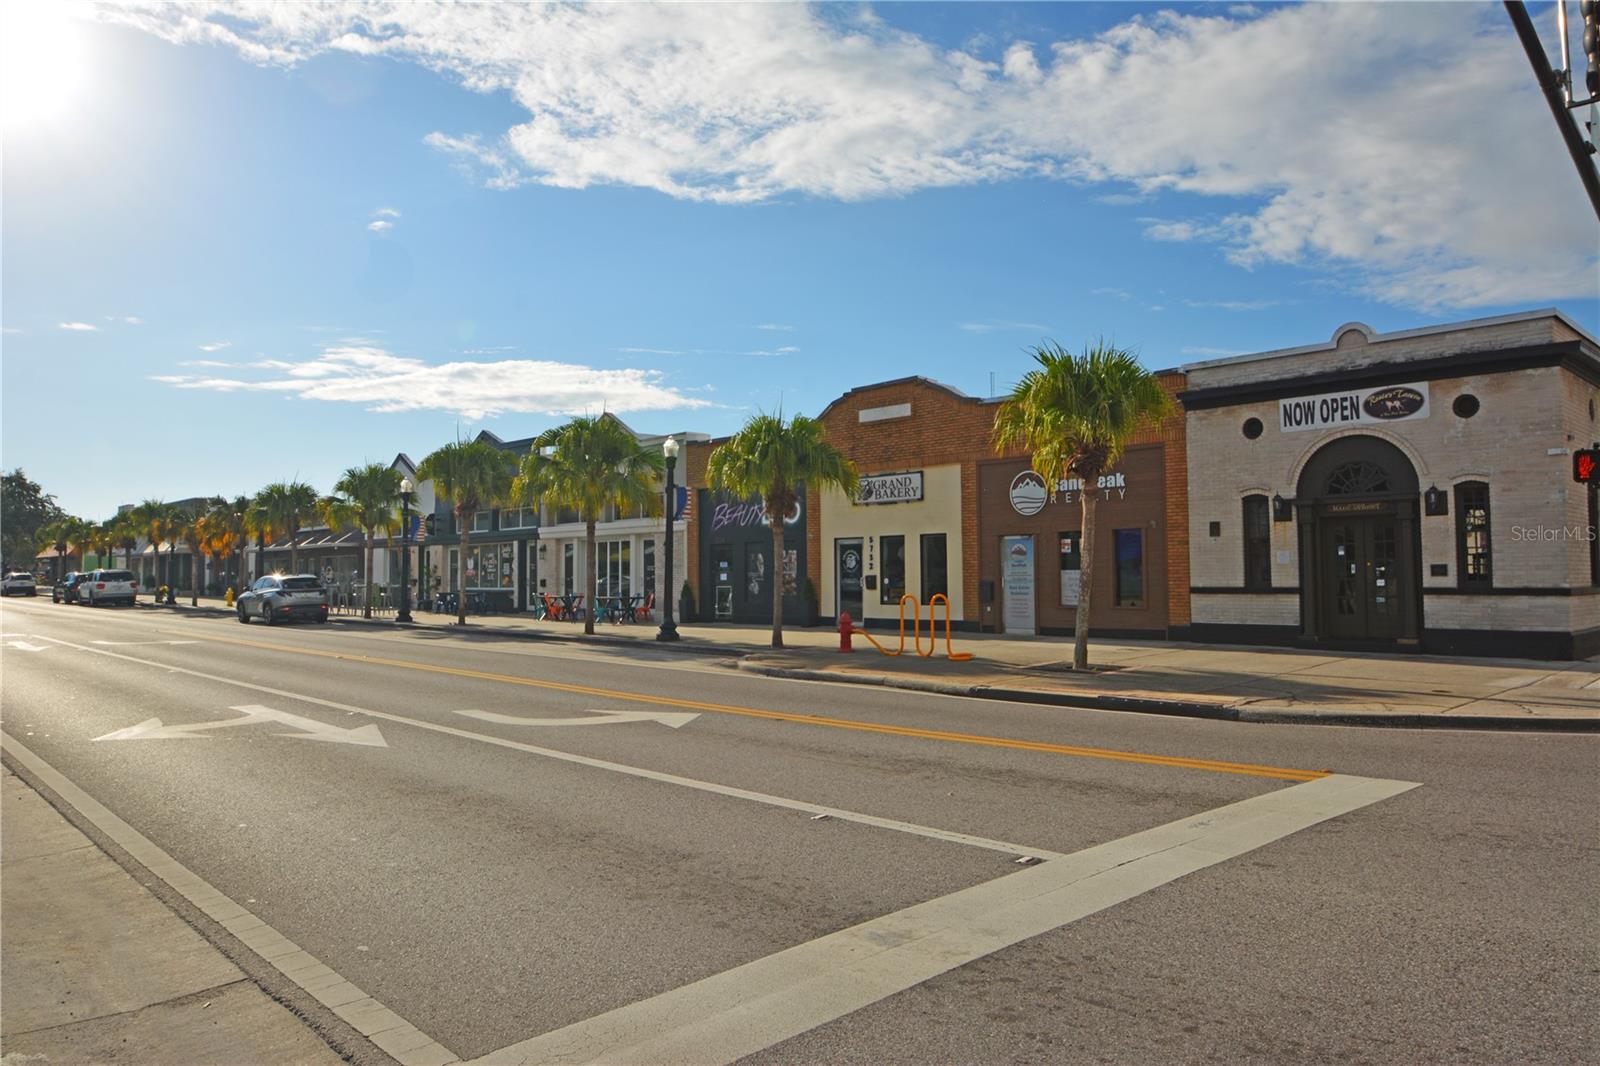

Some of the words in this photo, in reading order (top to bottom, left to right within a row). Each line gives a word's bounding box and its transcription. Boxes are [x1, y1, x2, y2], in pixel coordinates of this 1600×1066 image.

[1283, 401, 1315, 427] NOW
[1320, 395, 1360, 423] OPEN
[873, 476, 912, 490] GRAND
[875, 486, 919, 500] BAKERY
[1050, 489, 1126, 504] REATY
[712, 503, 767, 531] BEAUTY
